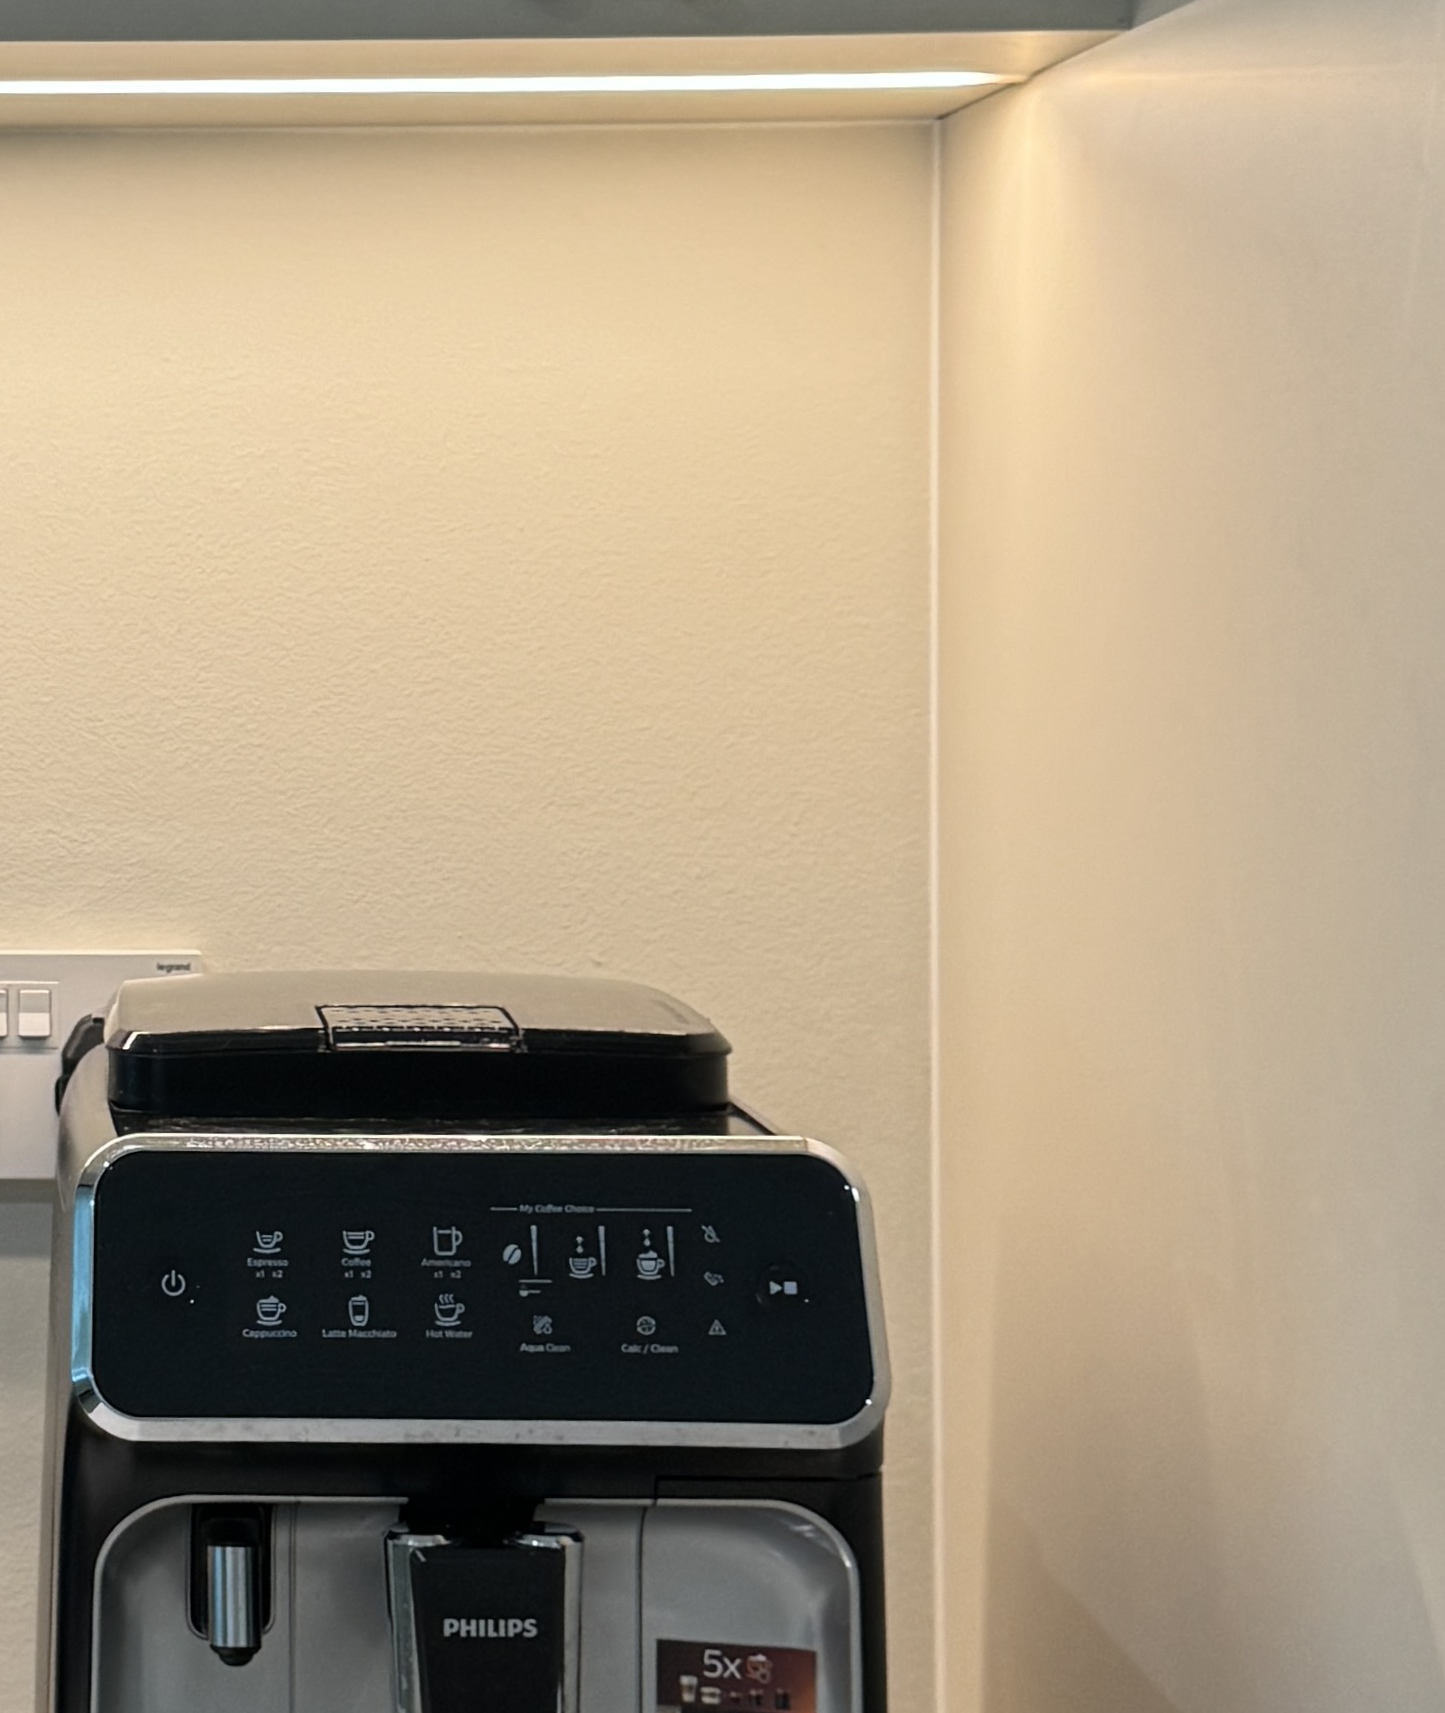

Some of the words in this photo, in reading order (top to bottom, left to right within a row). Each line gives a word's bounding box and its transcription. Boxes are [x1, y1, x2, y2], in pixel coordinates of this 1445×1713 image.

[156, 961, 191, 974] legrand
[519, 1204, 533, 1215] My
[535, 1204, 563, 1213] Coffee
[564, 1204, 595, 1214] Choice
[246, 1257, 289, 1268] Espresso
[341, 1257, 372, 1267] Coffee
[421, 1258, 472, 1268] Americano
[242, 1328, 297, 1339] Cappuccino
[322, 1328, 347, 1338] Latte
[348, 1328, 398, 1339] Macchiato
[425, 1328, 443, 1338] Hot
[445, 1328, 473, 1339] Water
[519, 1343, 545, 1354] Aqua
[545, 1343, 571, 1353] Clean
[621, 1343, 642, 1353] Calc
[650, 1343, 679, 1354] Clean
[443, 1617, 538, 1639] PHILIPS
[703, 1648, 742, 1680] 5x
